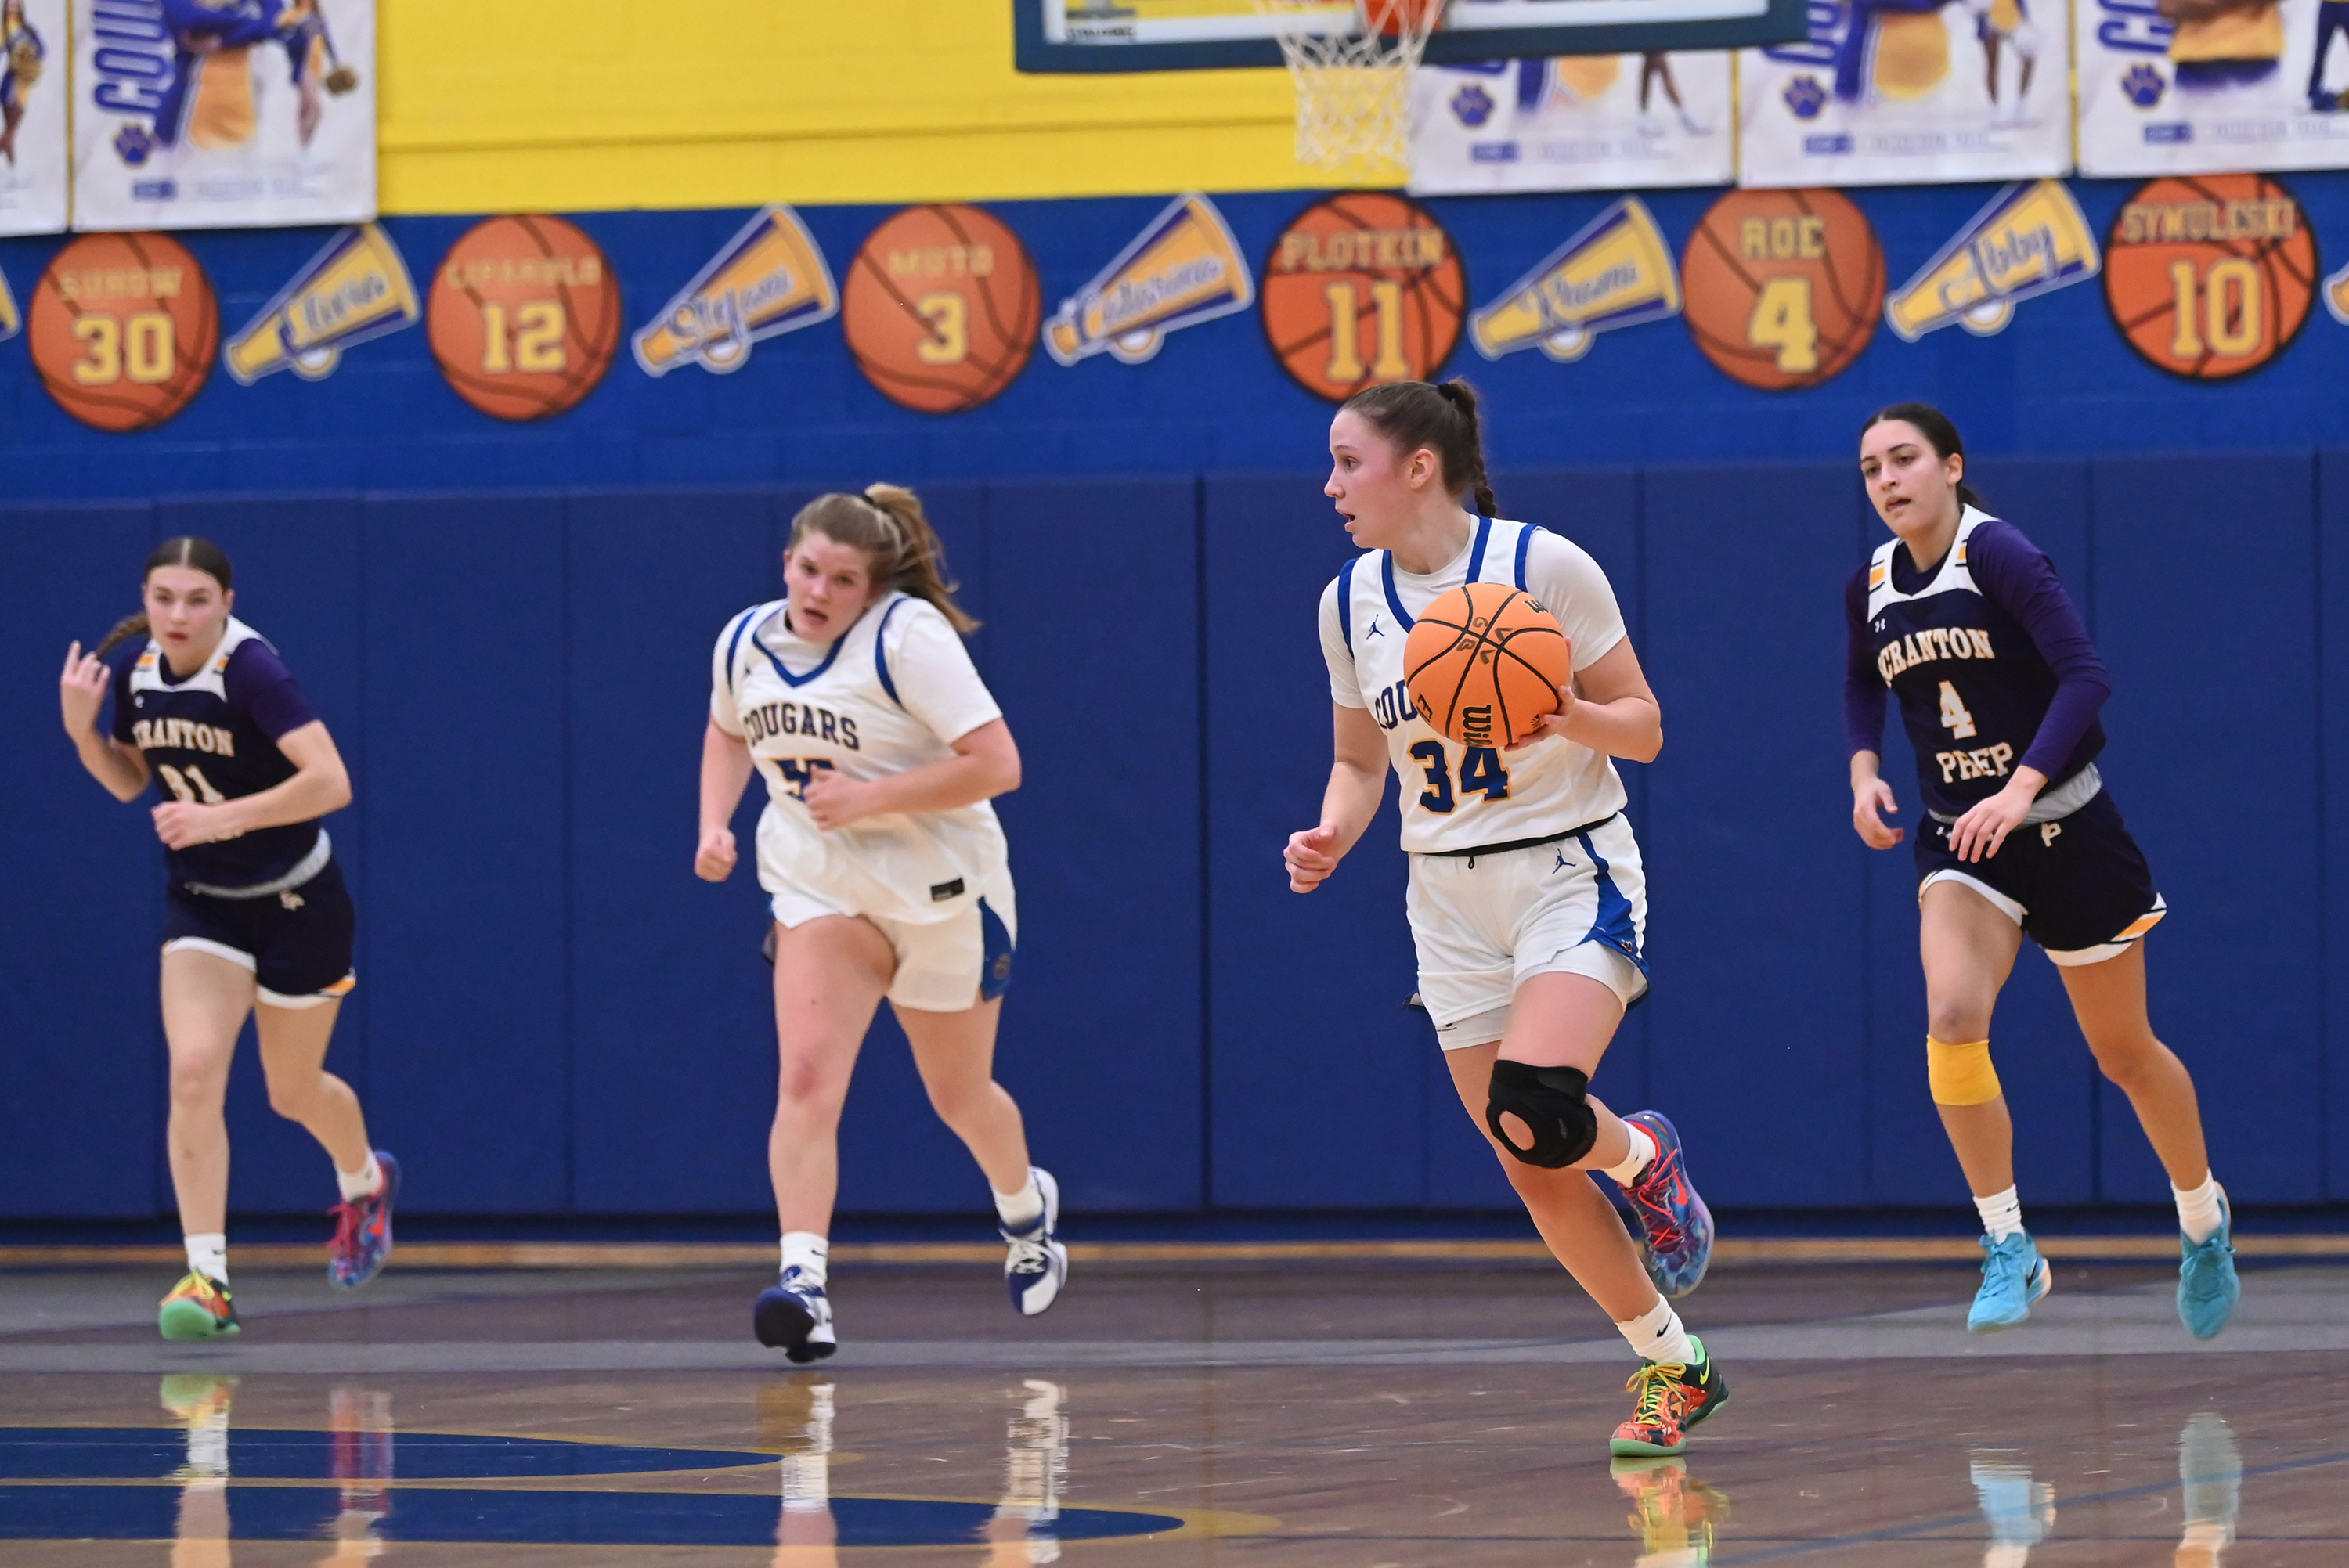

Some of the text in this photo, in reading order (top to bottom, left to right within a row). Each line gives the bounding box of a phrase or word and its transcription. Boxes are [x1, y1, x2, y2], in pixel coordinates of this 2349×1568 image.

[93, 0, 169, 115] COU
[1281, 229, 1445, 272] PLOTKIN
[482, 300, 565, 373] 12
[916, 290, 967, 366] 3
[1326, 280, 1409, 382] 11
[1748, 276, 1818, 373] 4
[2171, 258, 2261, 359] 10
[74, 312, 175, 386] 30
[1375, 679, 1418, 730] COU
[1462, 704, 1493, 748] Wil
[1939, 680, 1978, 740] 4
[1407, 738, 1512, 815] 34
